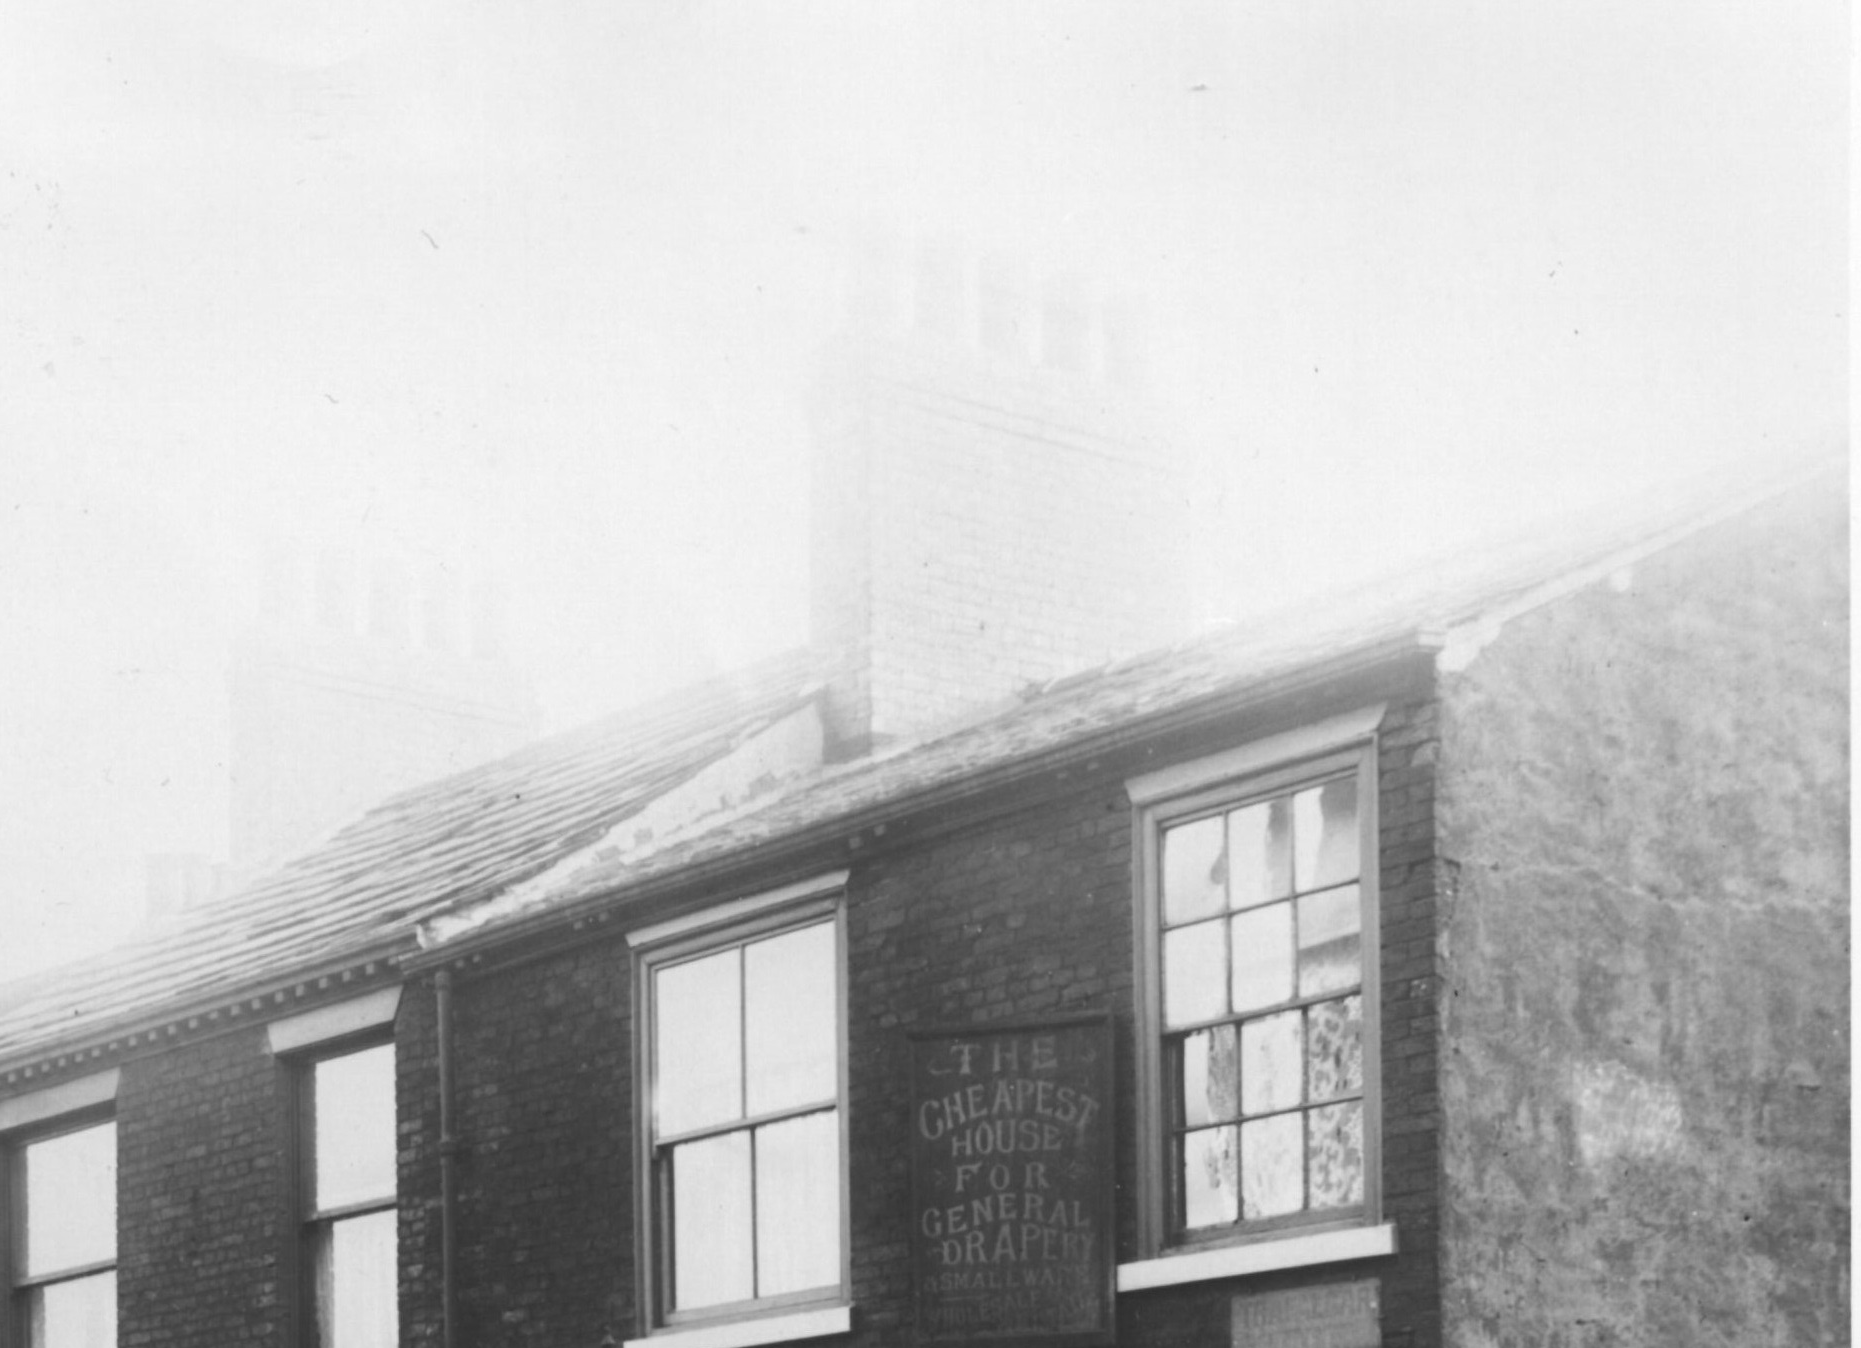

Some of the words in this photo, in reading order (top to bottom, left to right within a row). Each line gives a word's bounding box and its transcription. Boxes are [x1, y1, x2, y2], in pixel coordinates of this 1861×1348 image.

[951, 1035, 1058, 1075] THE
[920, 1079, 1099, 1140] CHEAPEST
[952, 1118, 1062, 1156] HOUSE
[955, 1161, 1049, 1193] FOR
[922, 1193, 1090, 1238] GENERAL
[942, 1223, 1095, 1265] DRAPERY
